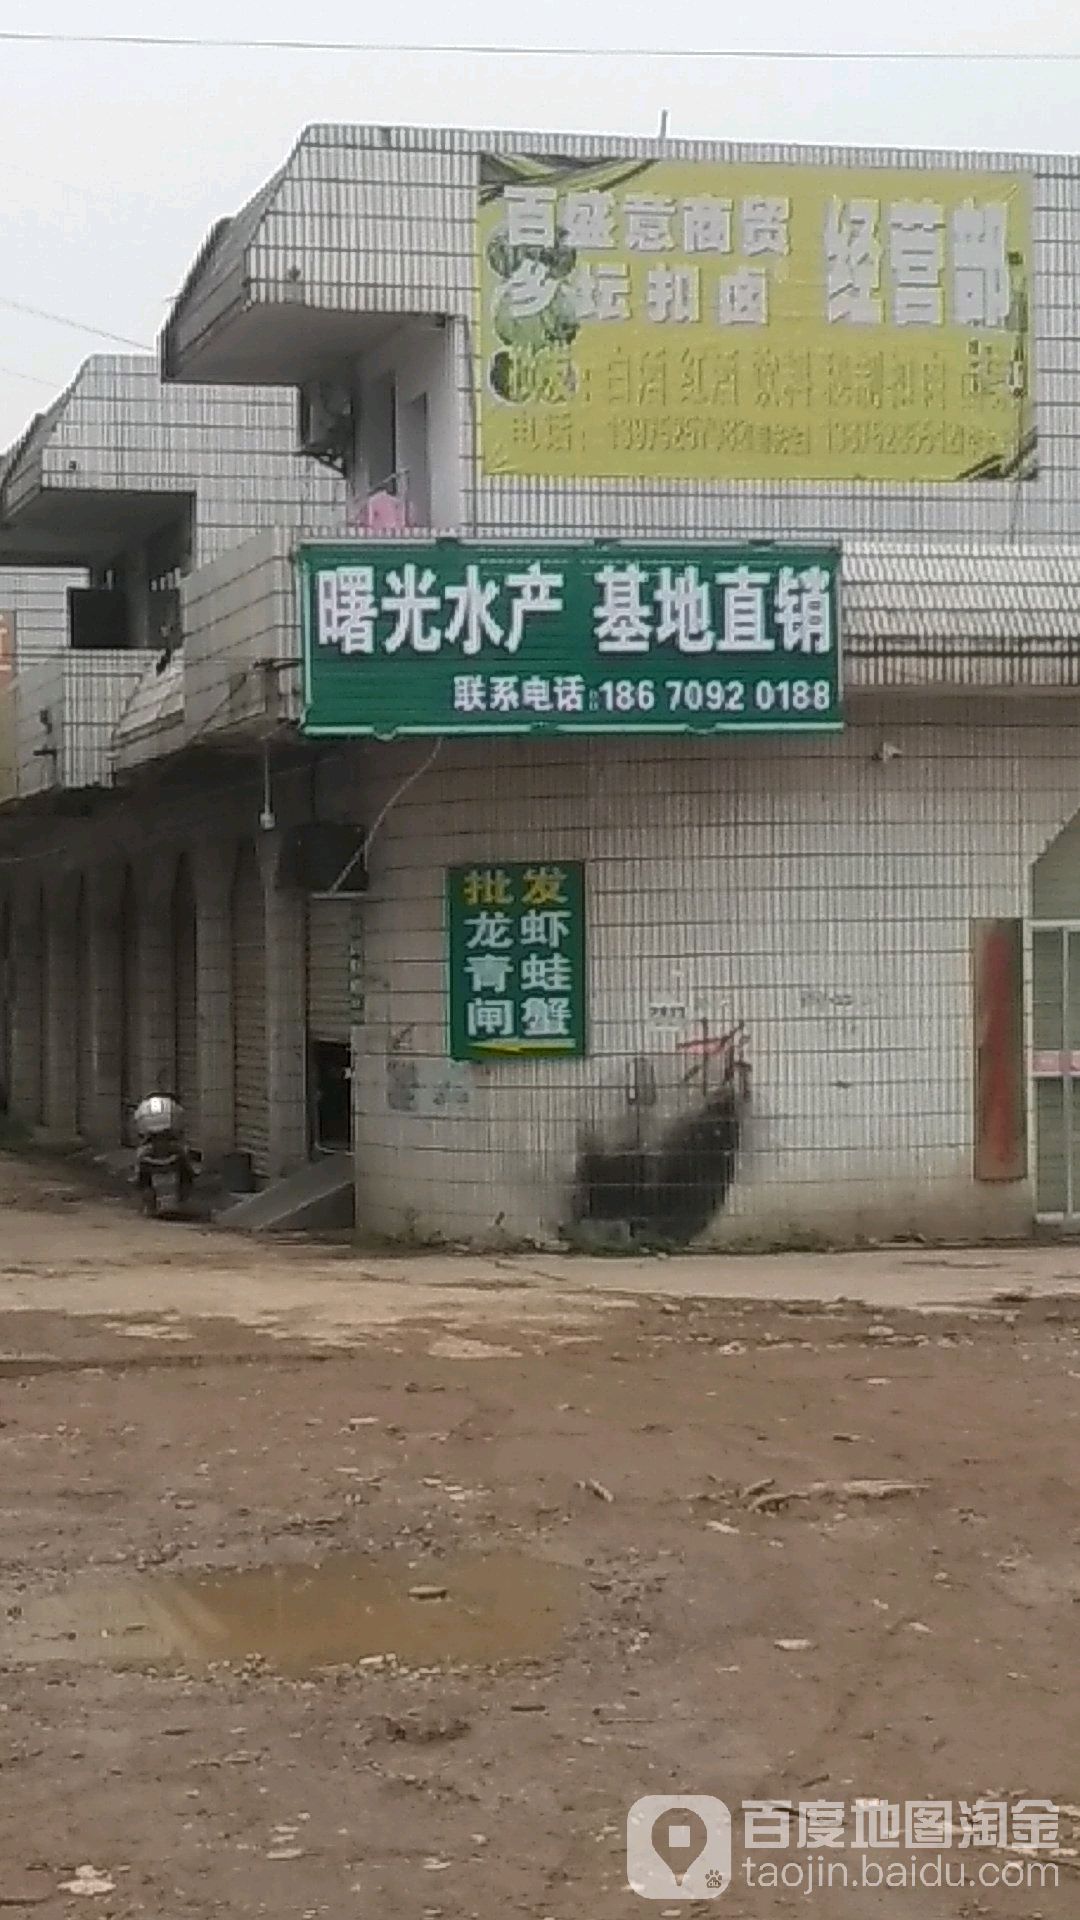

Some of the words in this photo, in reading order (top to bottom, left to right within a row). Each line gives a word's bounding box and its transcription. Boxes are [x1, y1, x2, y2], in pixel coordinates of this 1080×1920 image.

[503, 185, 791, 257] 百盛意商贸
[823, 195, 1010, 327] 经营部
[317, 562, 564, 655] 曙光水产
[593, 563, 832, 655] 基地直销
[664, 680, 745, 712] 7092
[755, 679, 831, 711] 0188
[464, 867, 569, 906] 批发
[464, 909, 572, 949] 龙虾
[464, 953, 572, 992] 青蛙
[468, 997, 572, 1037] 闸蟹
